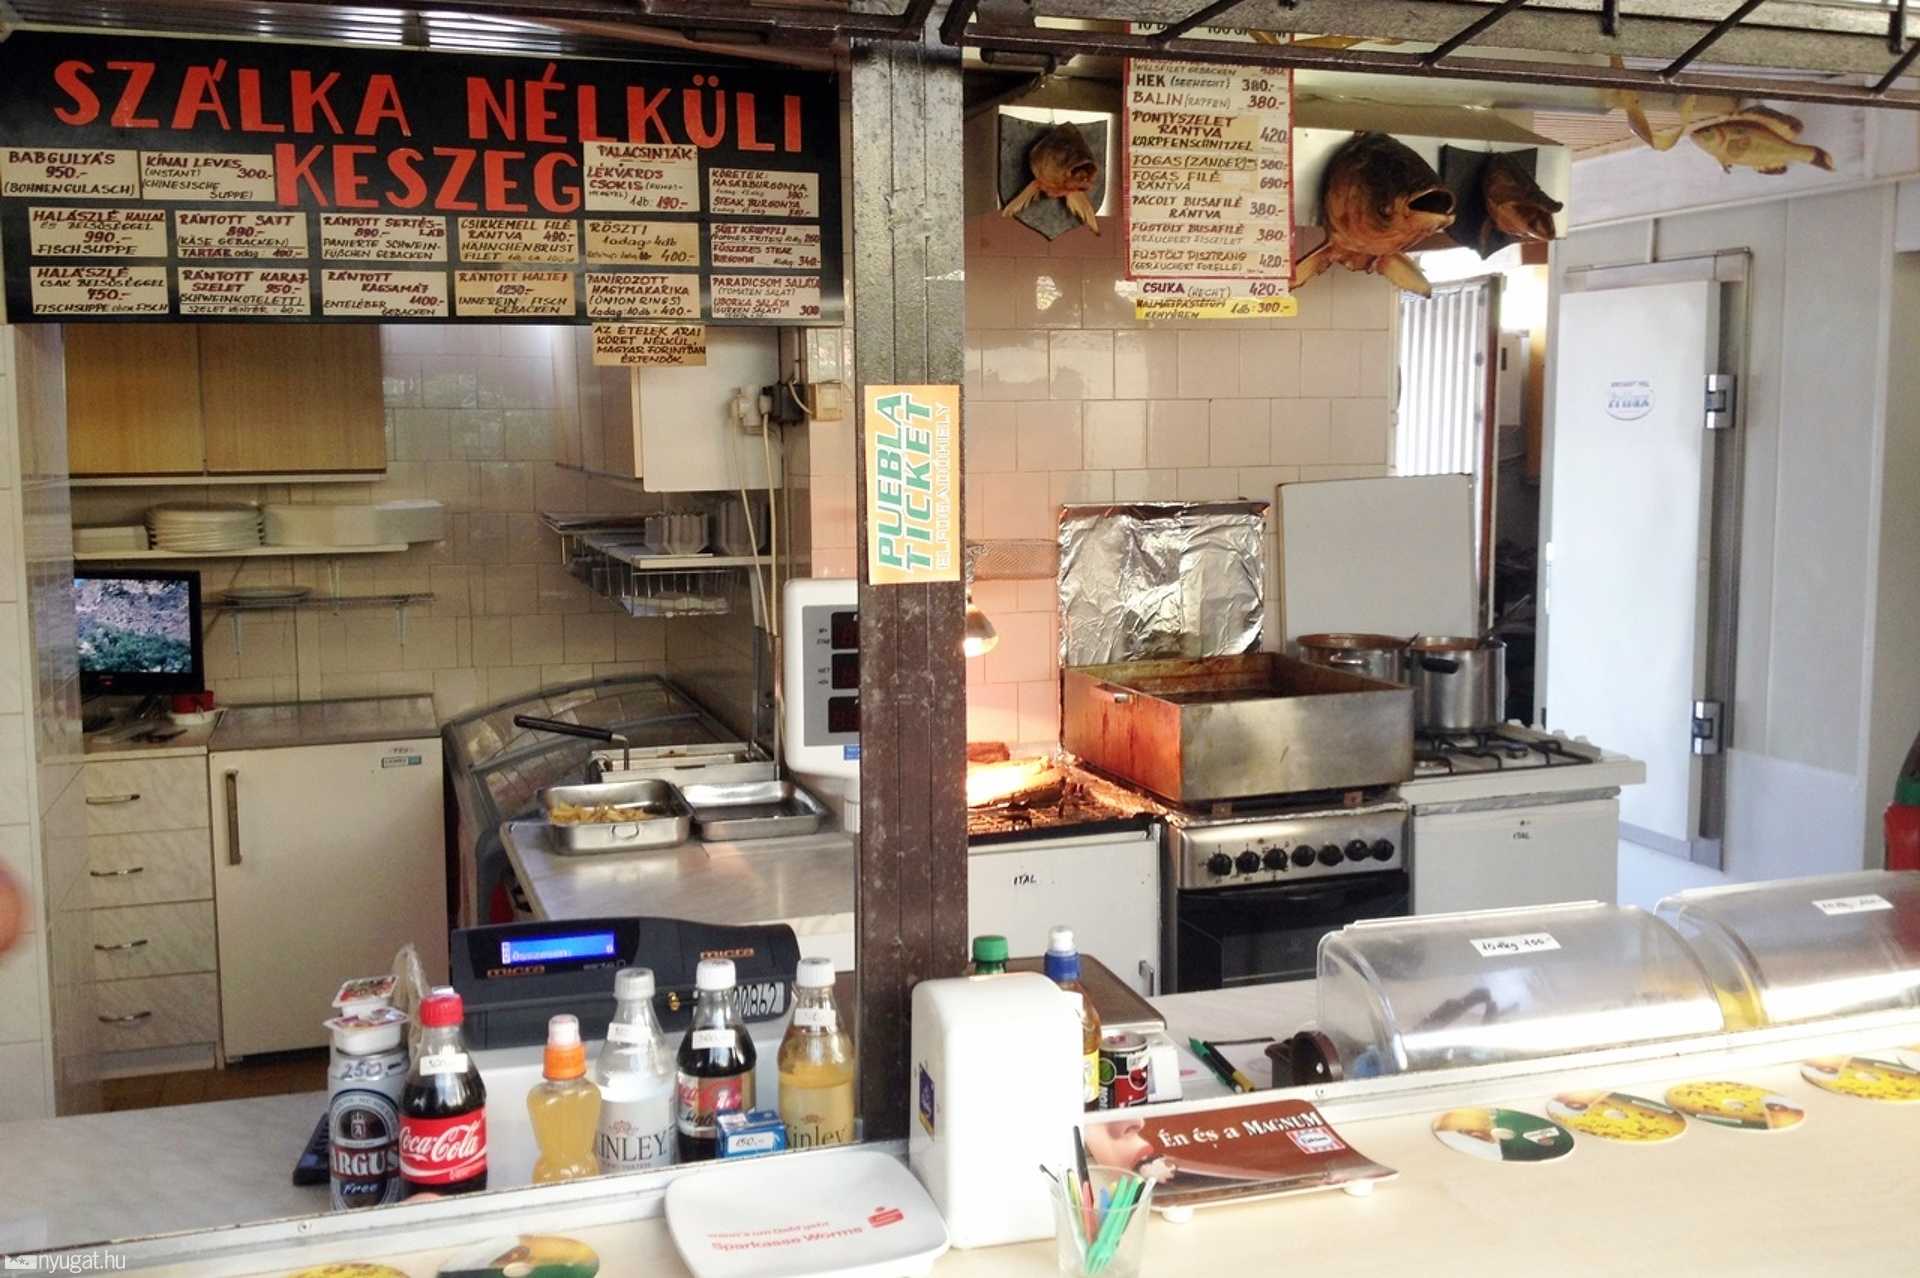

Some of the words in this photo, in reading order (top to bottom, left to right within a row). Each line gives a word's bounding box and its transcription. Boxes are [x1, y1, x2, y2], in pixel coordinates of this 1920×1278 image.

[1136, 74, 1165, 88] HEK
[1132, 91, 1184, 105] BALIN
[53, 60, 410, 135] SZÁLKA
[468, 63, 802, 152] NÉLKÜLI
[1132, 110, 1238, 128] PONTYSZELET
[1132, 135, 1253, 150] KARPFENSCHNITZEL
[9, 151, 115, 165] BABGULYÁS
[146, 153, 188, 167] KÍNAI
[193, 158, 242, 169] LEVES
[1132, 155, 1182, 167] FOGAS
[145, 167, 200, 177] (INSTANT)
[1132, 171, 1179, 182] FOGAS
[1188, 171, 1222, 183] FILÉ
[277, 144, 580, 213] KESZEG
[4, 181, 135, 196] (BOHNENGULASCH)
[589, 179, 643, 191] CSOKIS
[713, 197, 744, 206] STEAK
[1132, 196, 1177, 206] PÁCOLT
[1184, 196, 1243, 208] BUSAFILÉ
[33, 210, 120, 222] HALÁSZLÉ
[179, 213, 246, 225] RÁNTOTT
[1169, 207, 1221, 219] RÁNTVA
[461, 219, 537, 230] CSIRKEMELL
[589, 221, 648, 235] RÖSZTI
[1189, 224, 1245, 235] BUSAFILÉ
[38, 244, 137, 255] FISCHSUPPE
[376, 250, 433, 260] GEBACKEN
[464, 252, 501, 260] FILET
[37, 267, 129, 278] HALÁSZLÉ
[182, 269, 254, 281] RÁNTOTT
[192, 283, 245, 292] SZELET
[712, 277, 782, 287] PARADICSOM
[592, 285, 689, 295] HAGYMAKARIKA
[1143, 282, 1185, 294] CSUKA
[1187, 286, 1232, 298] (HECHT)
[35, 304, 108, 313] FISCHSUPPE
[494, 305, 560, 314] GEBACKEN
[594, 326, 611, 334] AZ
[617, 324, 668, 336] ÉTELEK
[597, 346, 645, 354] MAGYAR
[875, 392, 903, 569] PUEBLA
[904, 393, 933, 570] TICKET
[1157, 1128, 1189, 1147] Én
[1192, 1127, 1219, 1142] és
[1223, 1126, 1240, 1139] a
[399, 1122, 480, 1164] Coca-Cola
[598, 1130, 667, 1162] INLEY
[343, 1183, 379, 1196] Free
